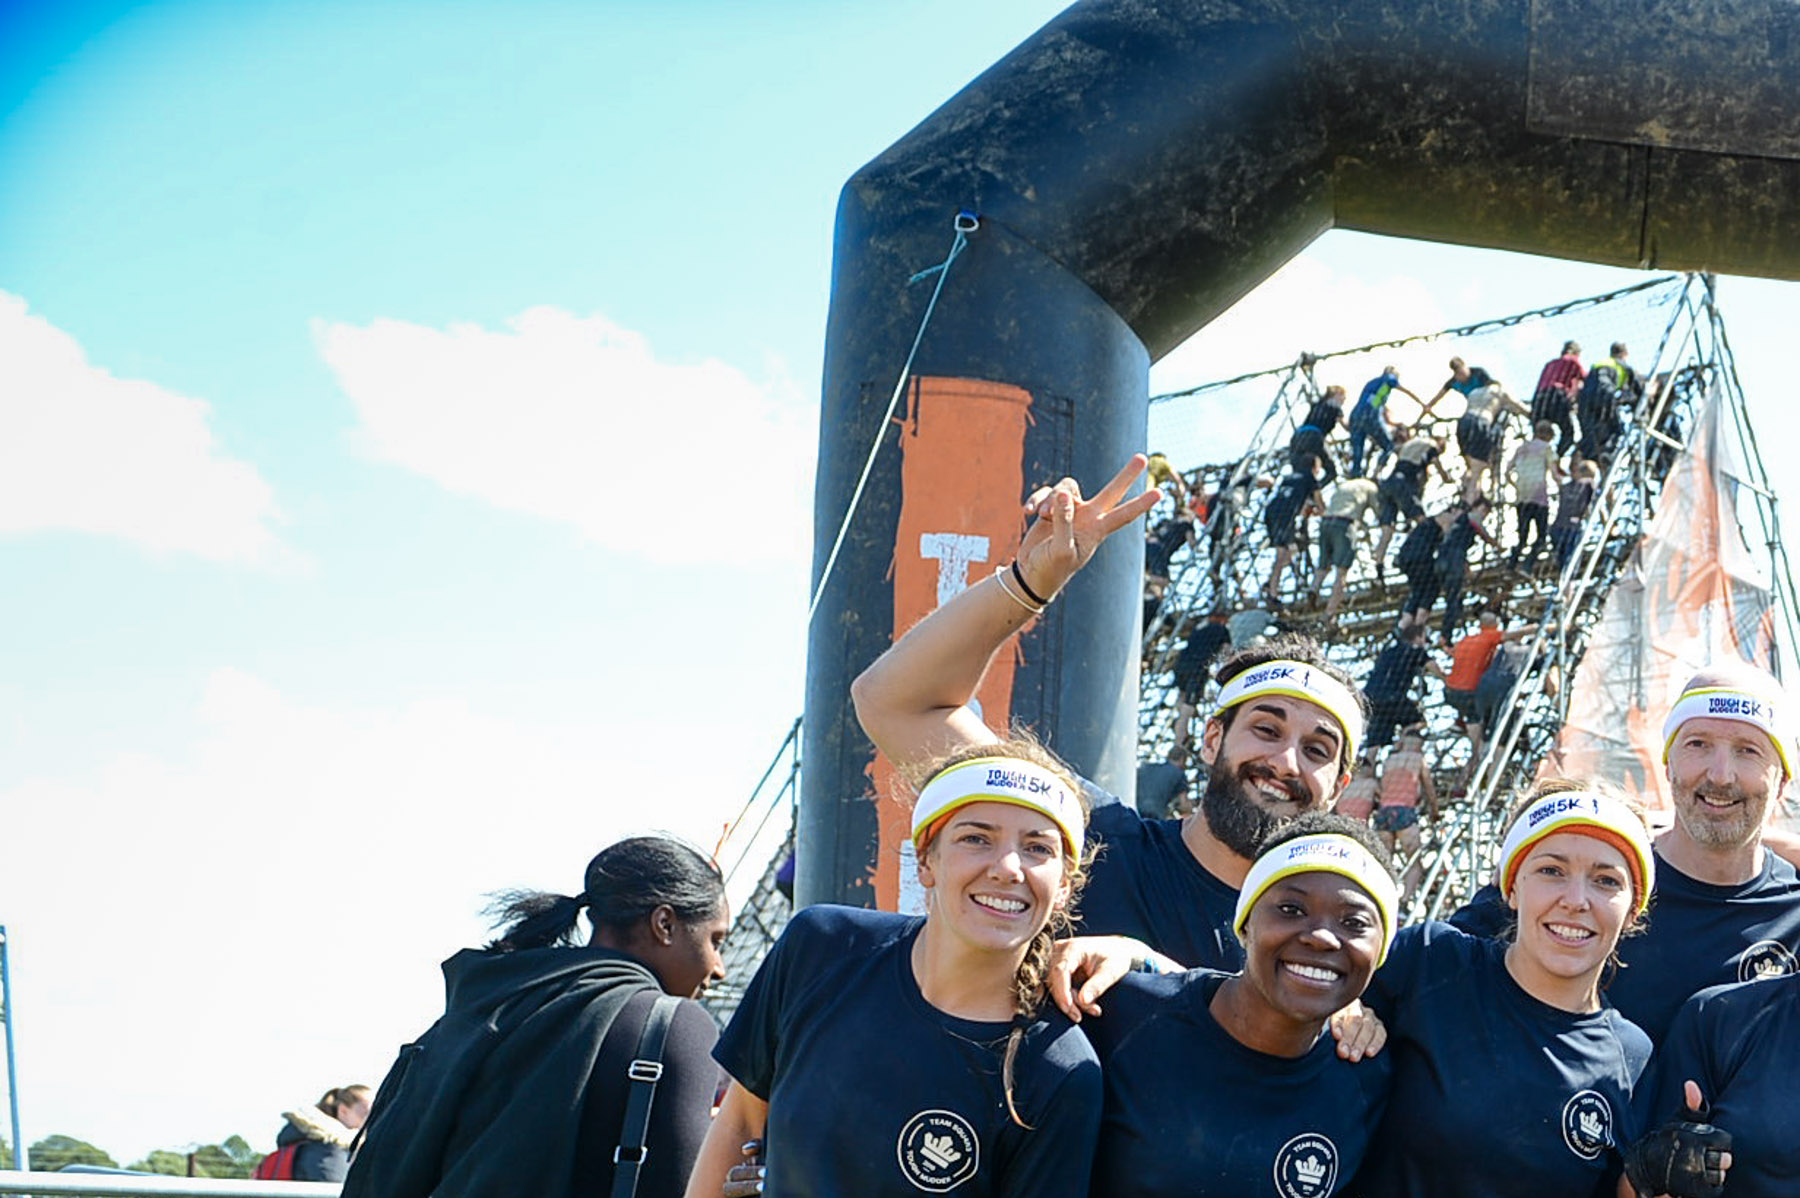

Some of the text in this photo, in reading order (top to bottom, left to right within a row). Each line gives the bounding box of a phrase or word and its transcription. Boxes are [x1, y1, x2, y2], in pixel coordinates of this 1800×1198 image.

[1270, 668, 1296, 682] 5K
[1709, 698, 1763, 716] TOUGH 5K
[988, 769, 1051, 796] TOUGH 5K
[1557, 798, 1583, 812] 5K
[929, 1118, 952, 1128] TEAM
